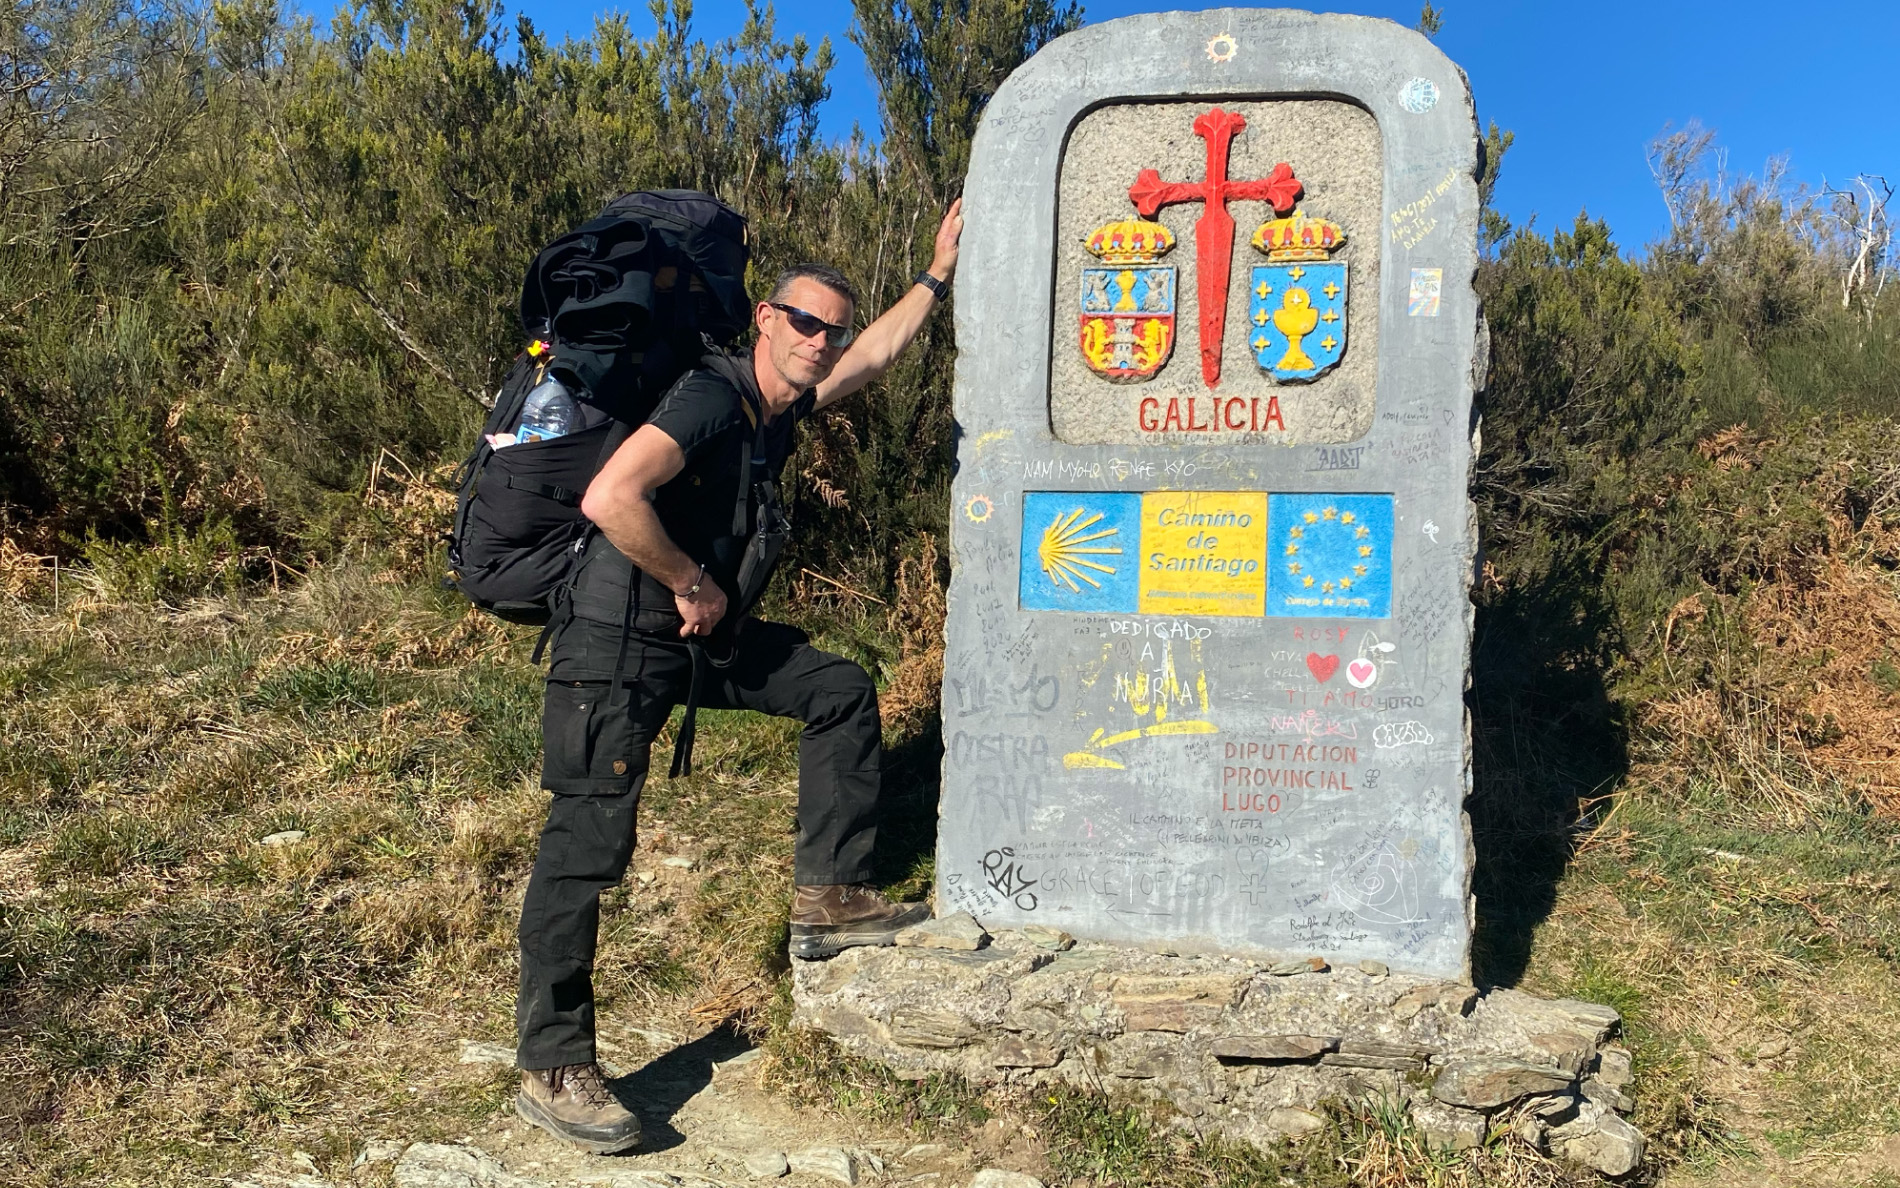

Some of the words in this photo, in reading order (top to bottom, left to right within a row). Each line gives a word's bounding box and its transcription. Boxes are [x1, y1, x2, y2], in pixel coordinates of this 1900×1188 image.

[1139, 396, 1286, 432] GALICIA
[1023, 459, 1054, 480] NAM
[1164, 458, 1196, 480] KYO
[1187, 531, 1219, 550] de
[1149, 552, 1259, 577] Santiago
[1293, 625, 1350, 643] ROSY
[1140, 641, 1155, 662] A
[1323, 690, 1374, 708] AMO
[1225, 742, 1357, 763] DIPUTACION
[1223, 766, 1353, 791] PROVINCIAL
[1222, 793, 1282, 813] LUGO
[1231, 819, 1264, 829] META
[1040, 866, 1118, 896] GRACE
[1140, 870, 1168, 896] OF
[1176, 872, 1226, 897] GOD
